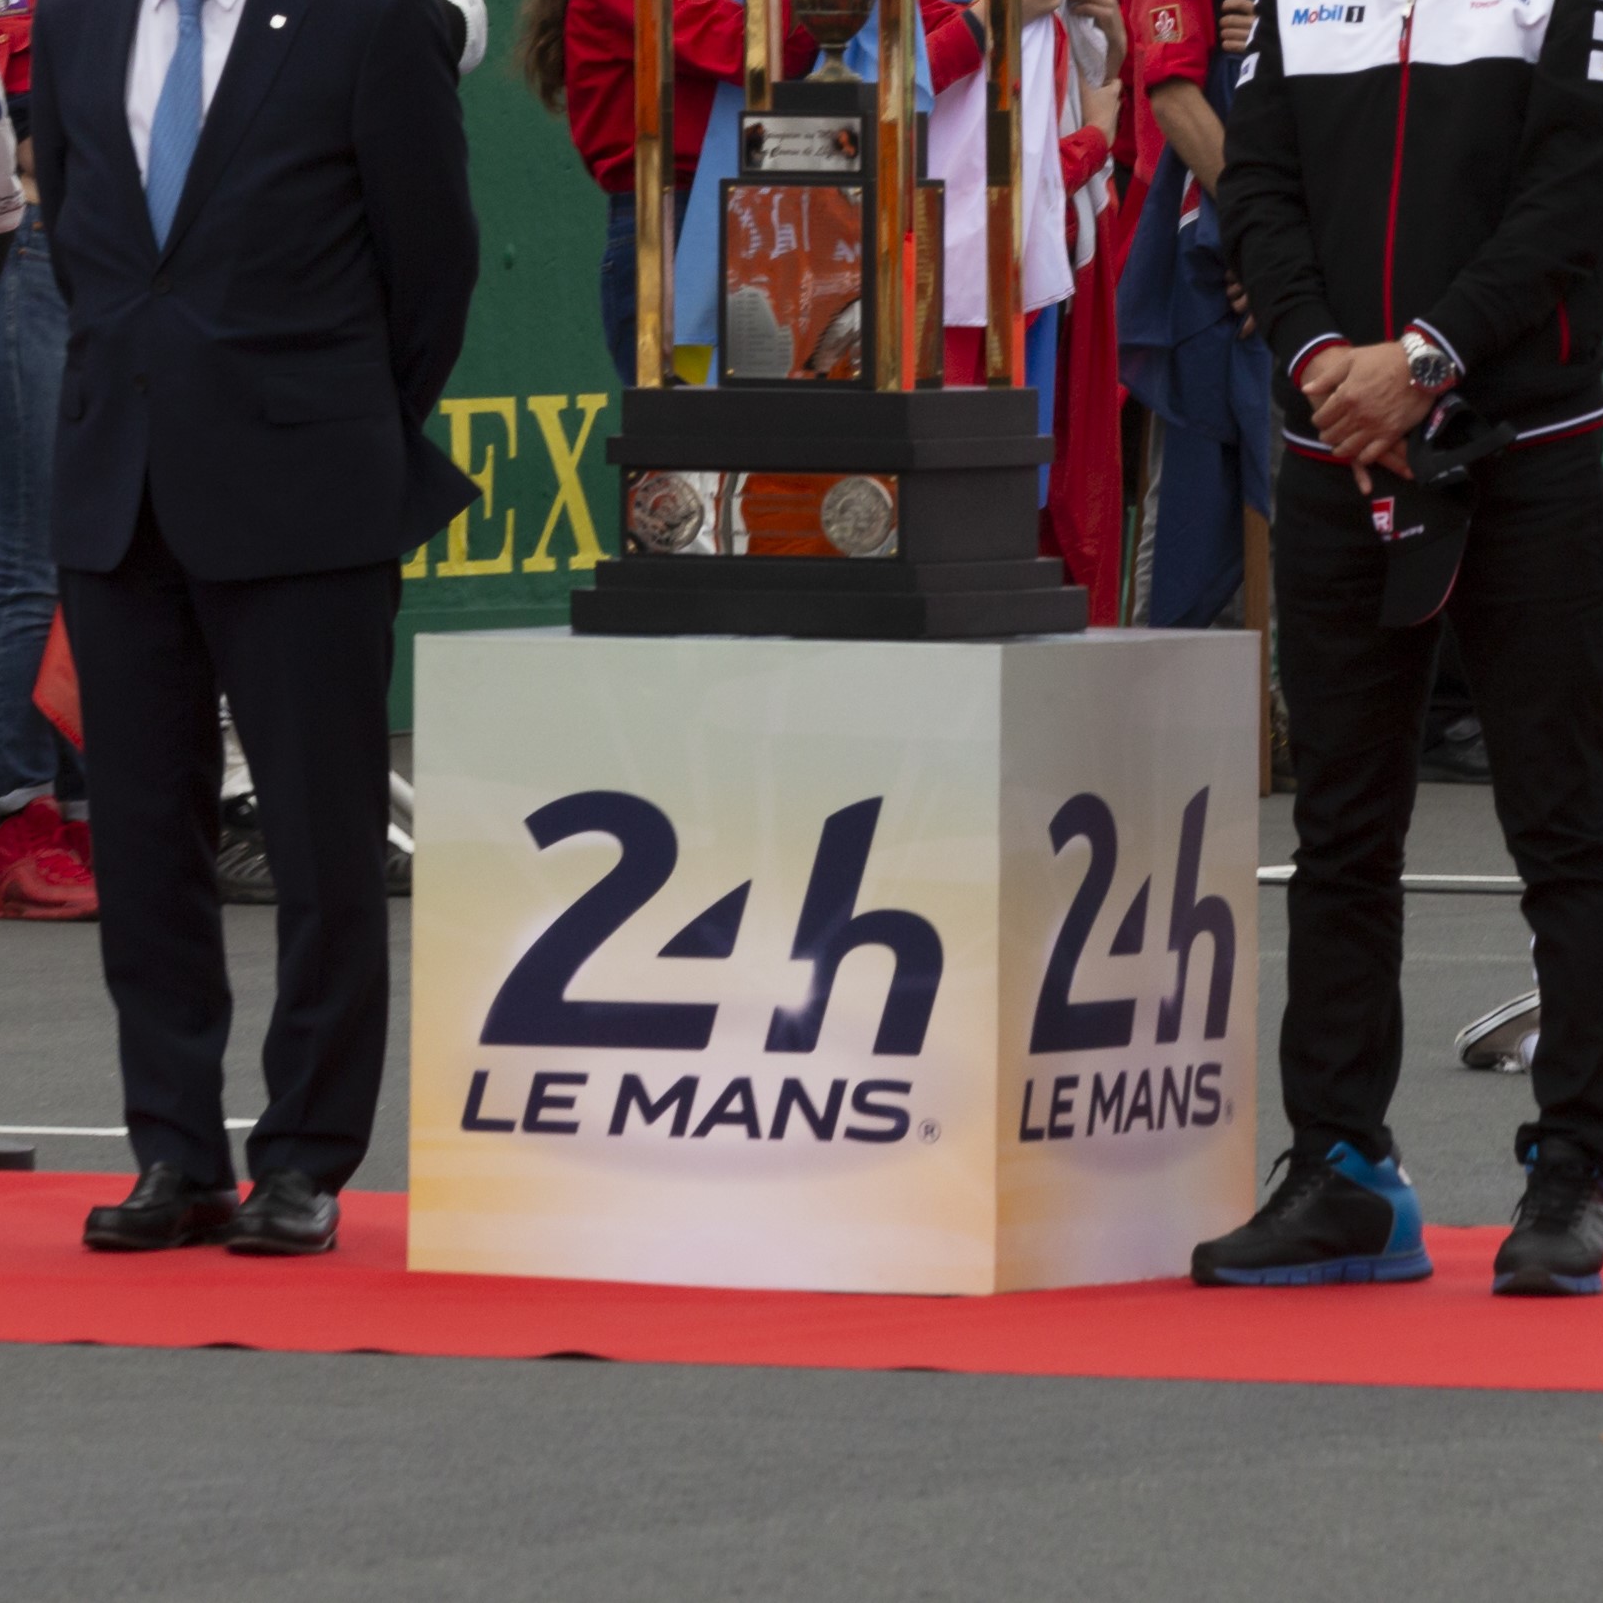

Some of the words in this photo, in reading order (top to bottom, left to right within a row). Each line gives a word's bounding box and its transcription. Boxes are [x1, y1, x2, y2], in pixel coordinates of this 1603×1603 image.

[1291, 3, 1343, 26] Mobil
[1347, 5, 1363, 23] 1
[401, 393, 612, 576] EX
[479, 790, 944, 1056] 24h
[1028, 785, 1236, 1055] 24h
[461, 1069, 589, 1134] LE
[607, 1073, 913, 1144] MANS
[1019, 1074, 1080, 1142] LE
[1085, 1061, 1223, 1138] MANS
